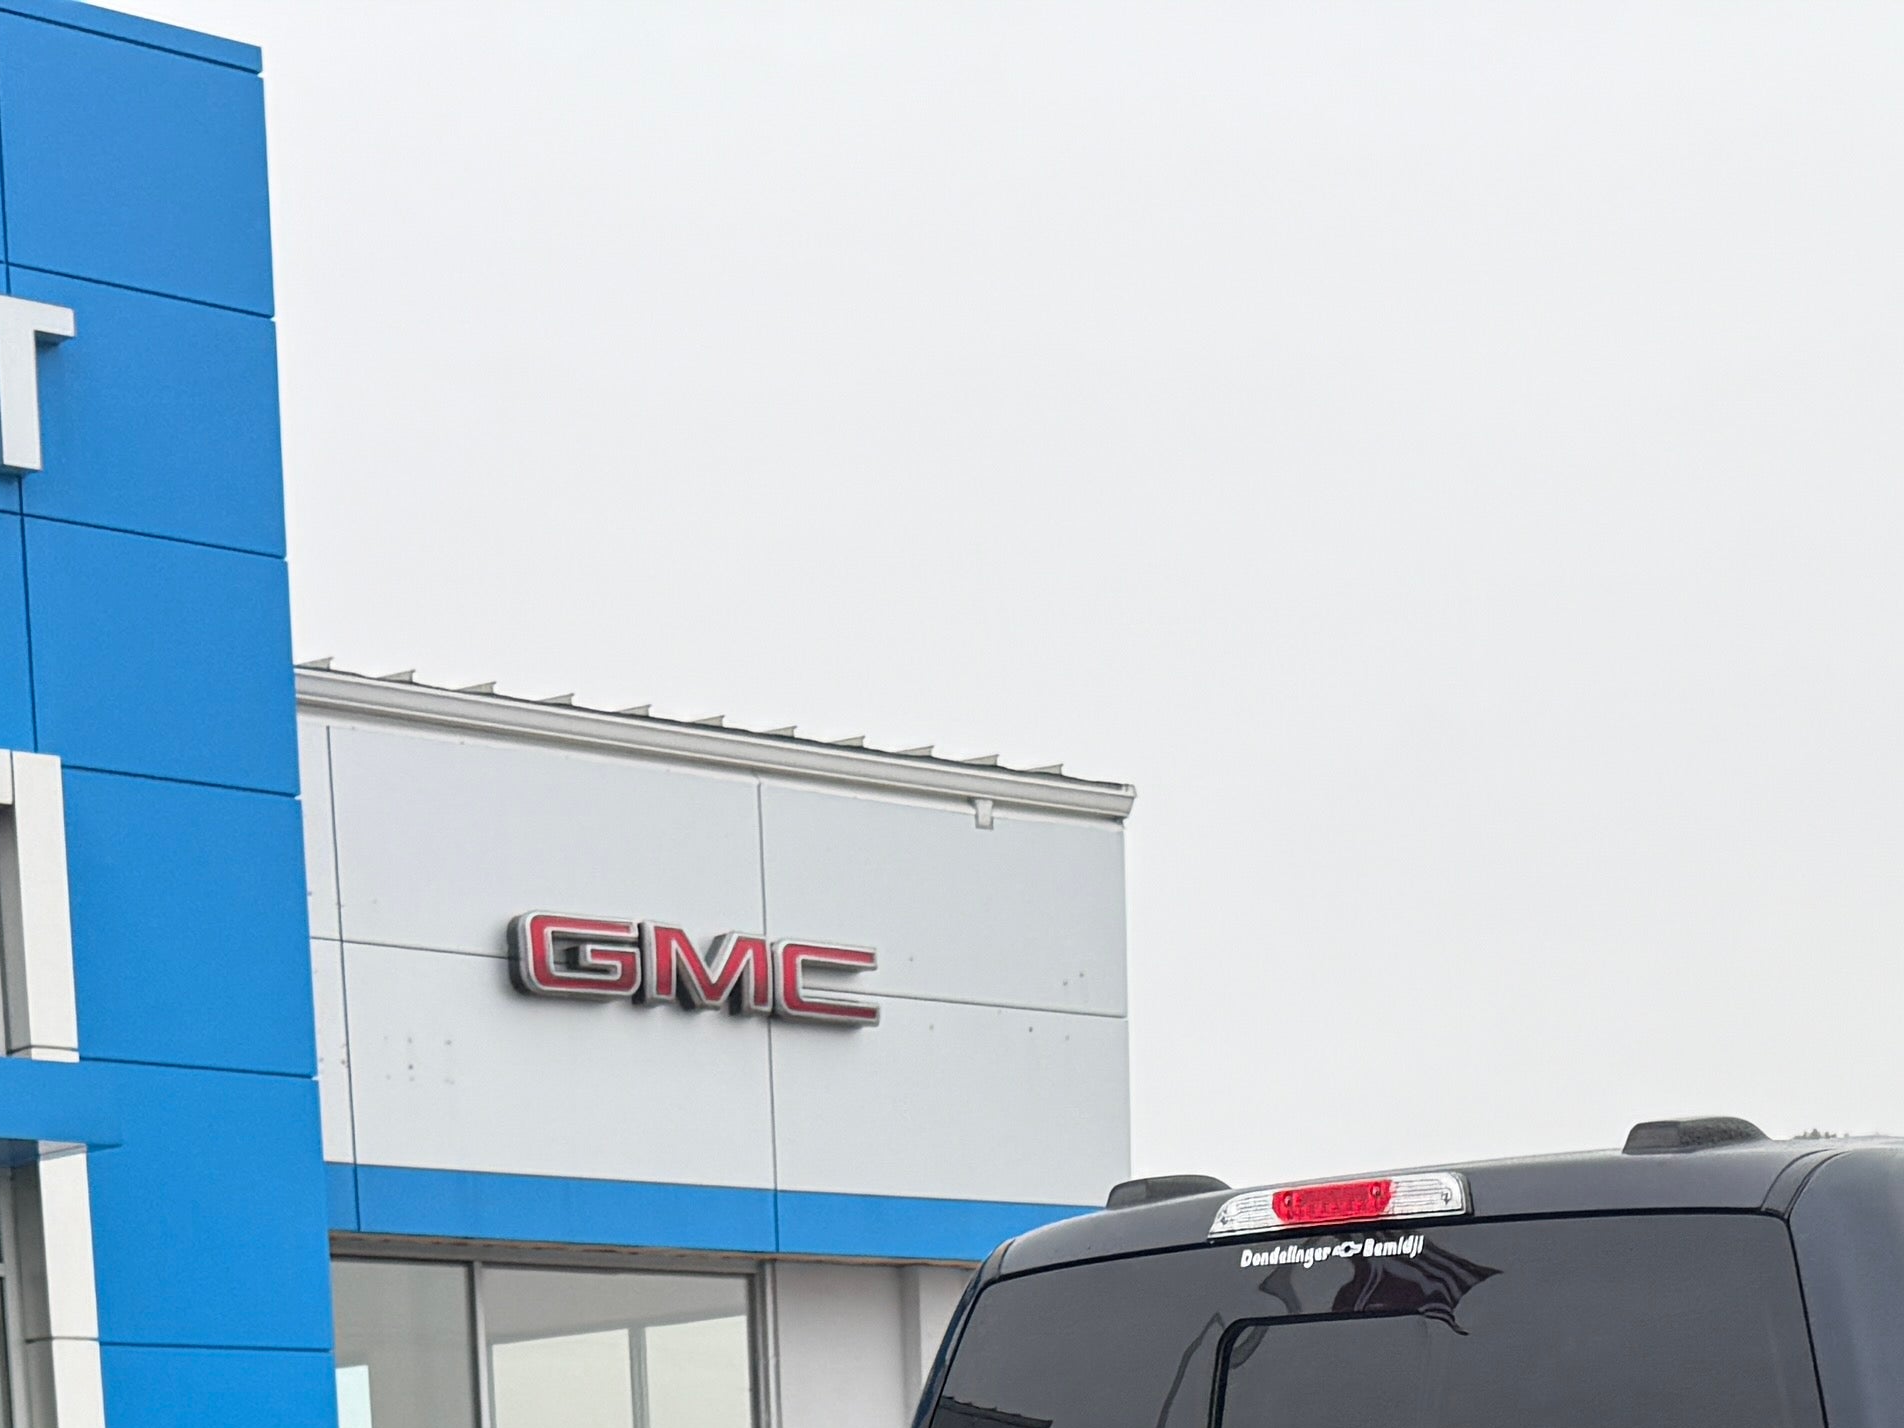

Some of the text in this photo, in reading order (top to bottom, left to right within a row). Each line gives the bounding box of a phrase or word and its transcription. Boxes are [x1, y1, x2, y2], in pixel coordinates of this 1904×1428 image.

[509, 909, 881, 1028] GMC
[1240, 1235, 1425, 1269] Dondelinger Bemidji
